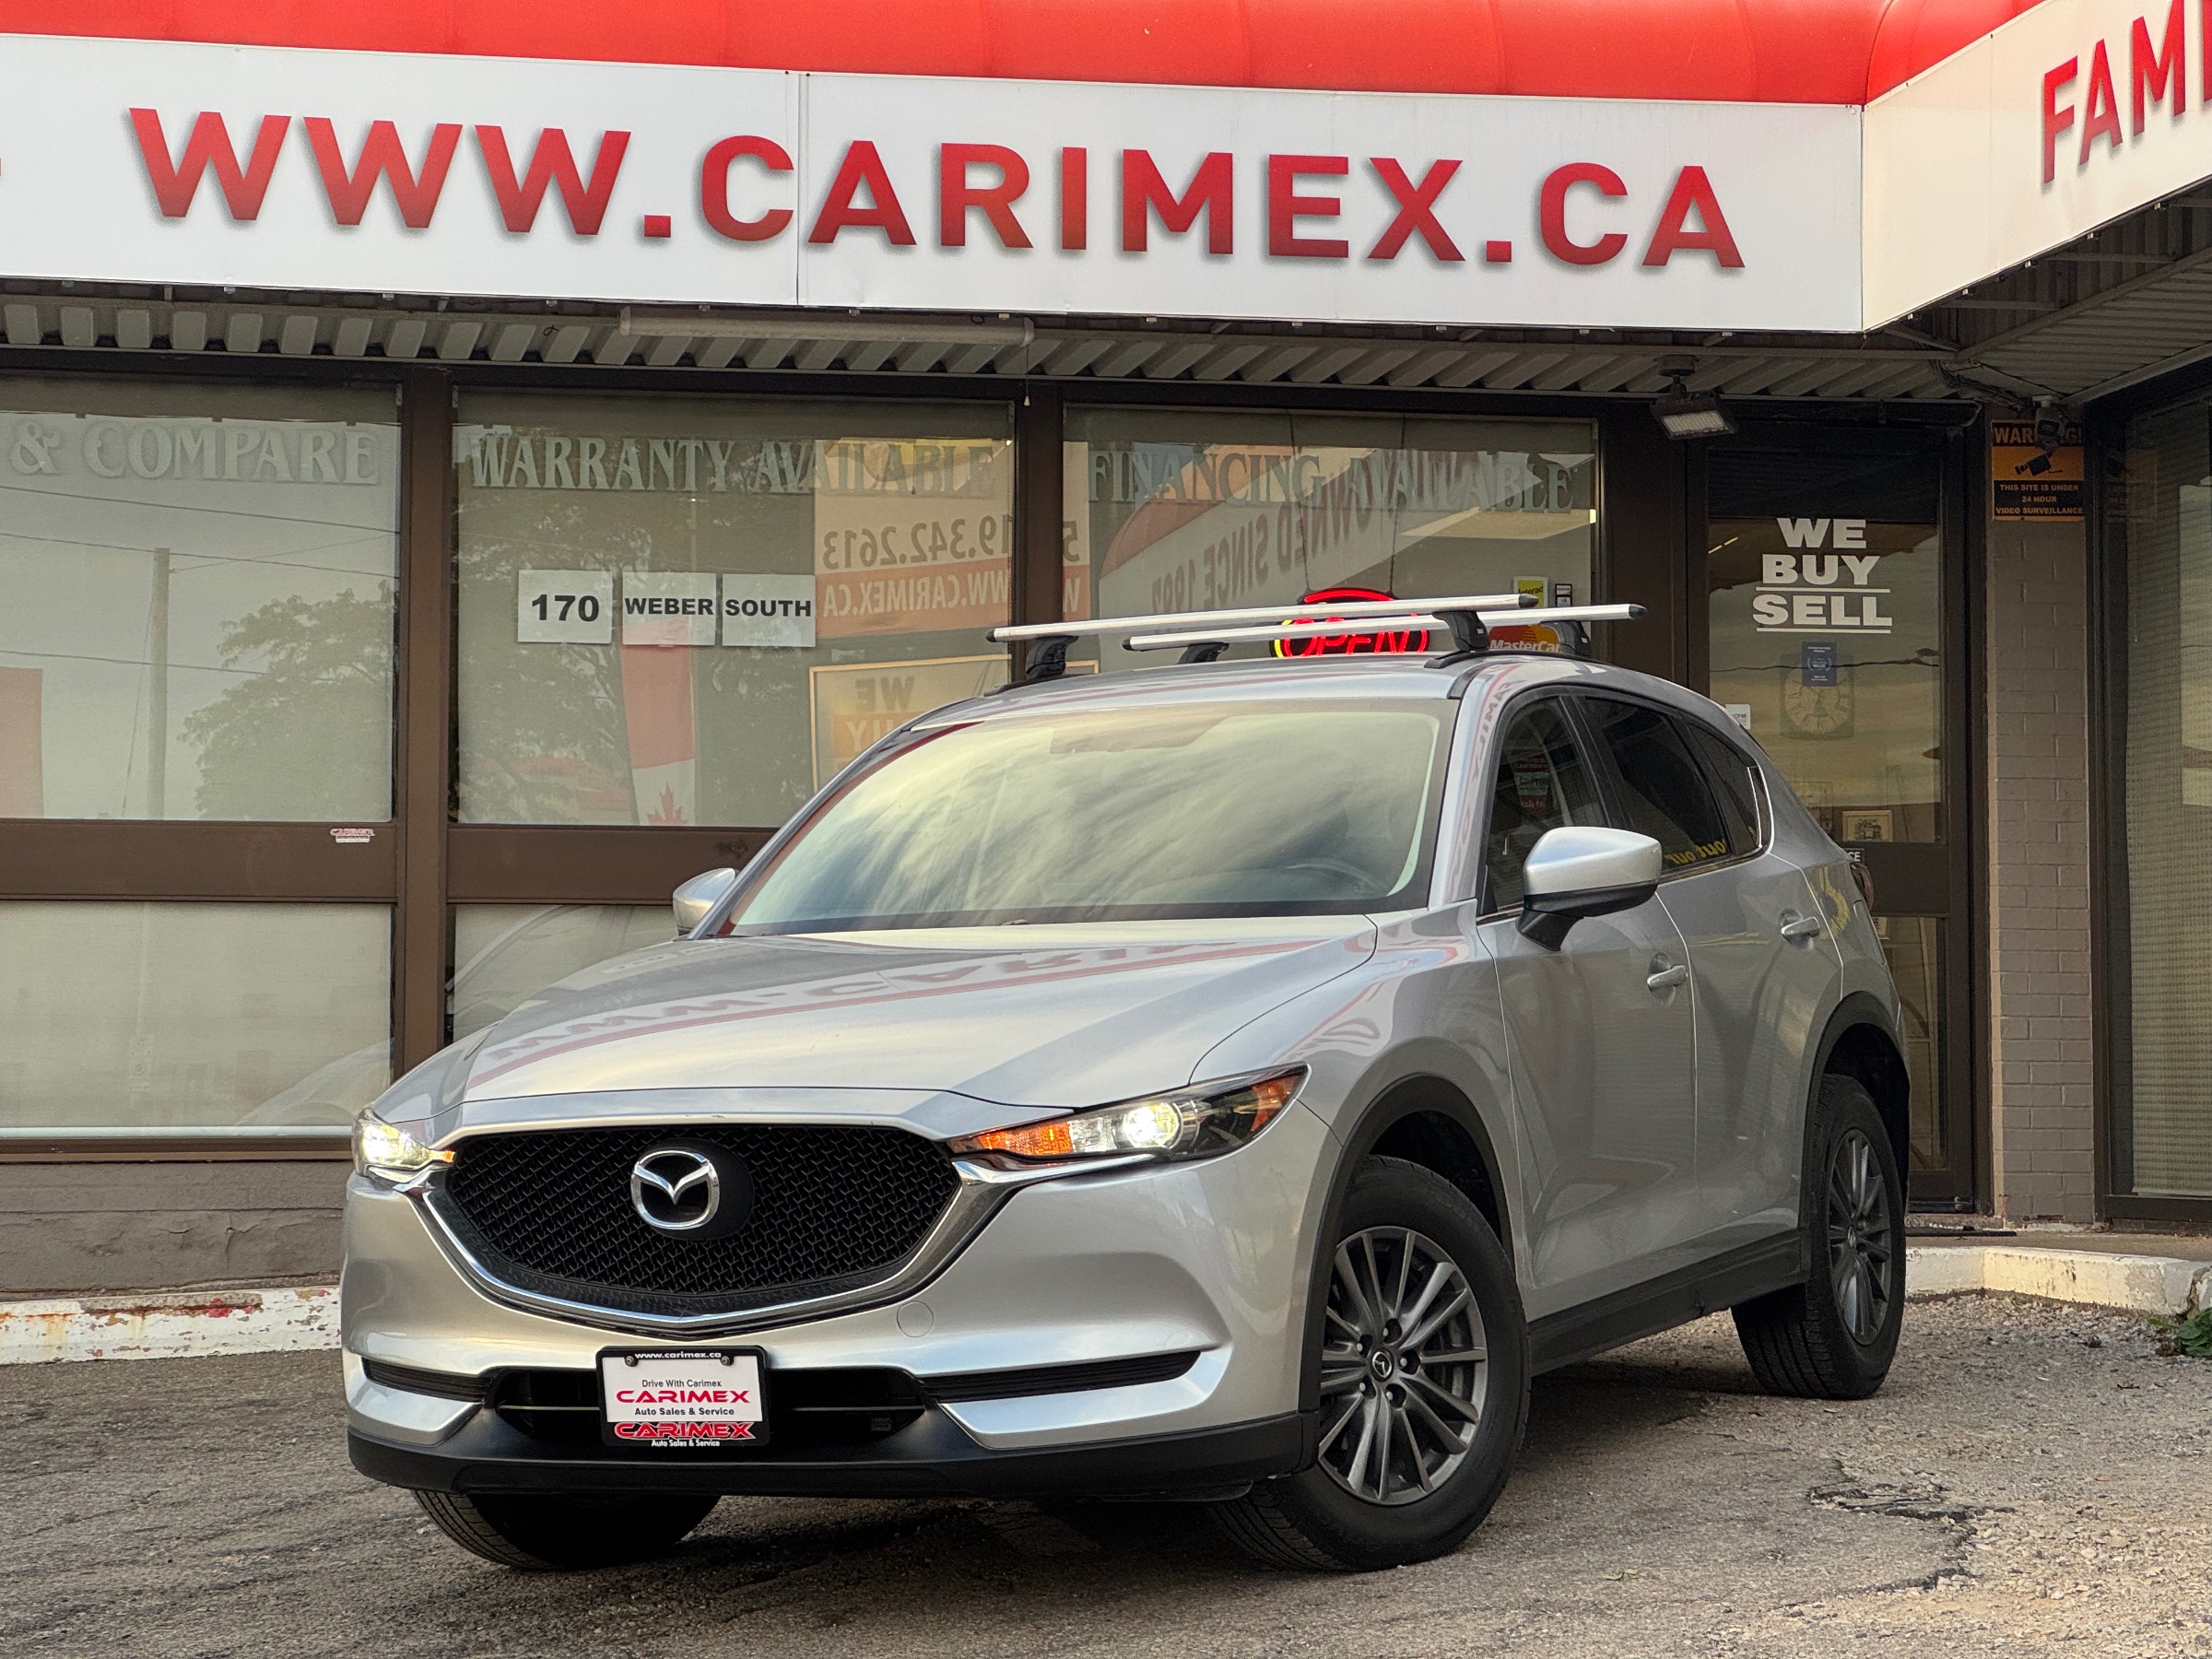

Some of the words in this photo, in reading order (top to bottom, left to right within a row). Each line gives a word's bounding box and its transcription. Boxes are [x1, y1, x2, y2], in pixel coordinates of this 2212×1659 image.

[129, 108, 1745, 268] WWW.CARIMEX.CA
[1994, 427, 2082, 443] WARG!
[10, 421, 60, 475] &
[84, 424, 380, 486] COMPARE
[472, 433, 735, 492] WARRANTY
[754, 439, 995, 499] AVAILABLE
[1088, 450, 1325, 506] FINANCING
[1347, 456, 1572, 513] AVAILABLE
[1776, 518, 1866, 548] WE
[1762, 554, 1880, 585] BUY
[531, 594, 599, 622] 170
[625, 597, 714, 616] WEBER
[725, 599, 812, 618] SOUTH
[1752, 594, 1892, 626] SELL
[1489, 639, 1563, 653] MasterCar
[634, 1351, 722, 1359] www.carimex.ca
[616, 1390, 750, 1404] CARIMEX
[665, 1379, 685, 1387] With
[686, 1380, 722, 1388] Carimex
[634, 1407, 657, 1416] Auto
[659, 1407, 686, 1416] Sales
[688, 1407, 695, 1416] &
[699, 1407, 735, 1416] Service
[615, 1421, 756, 1440] CARIMEX
